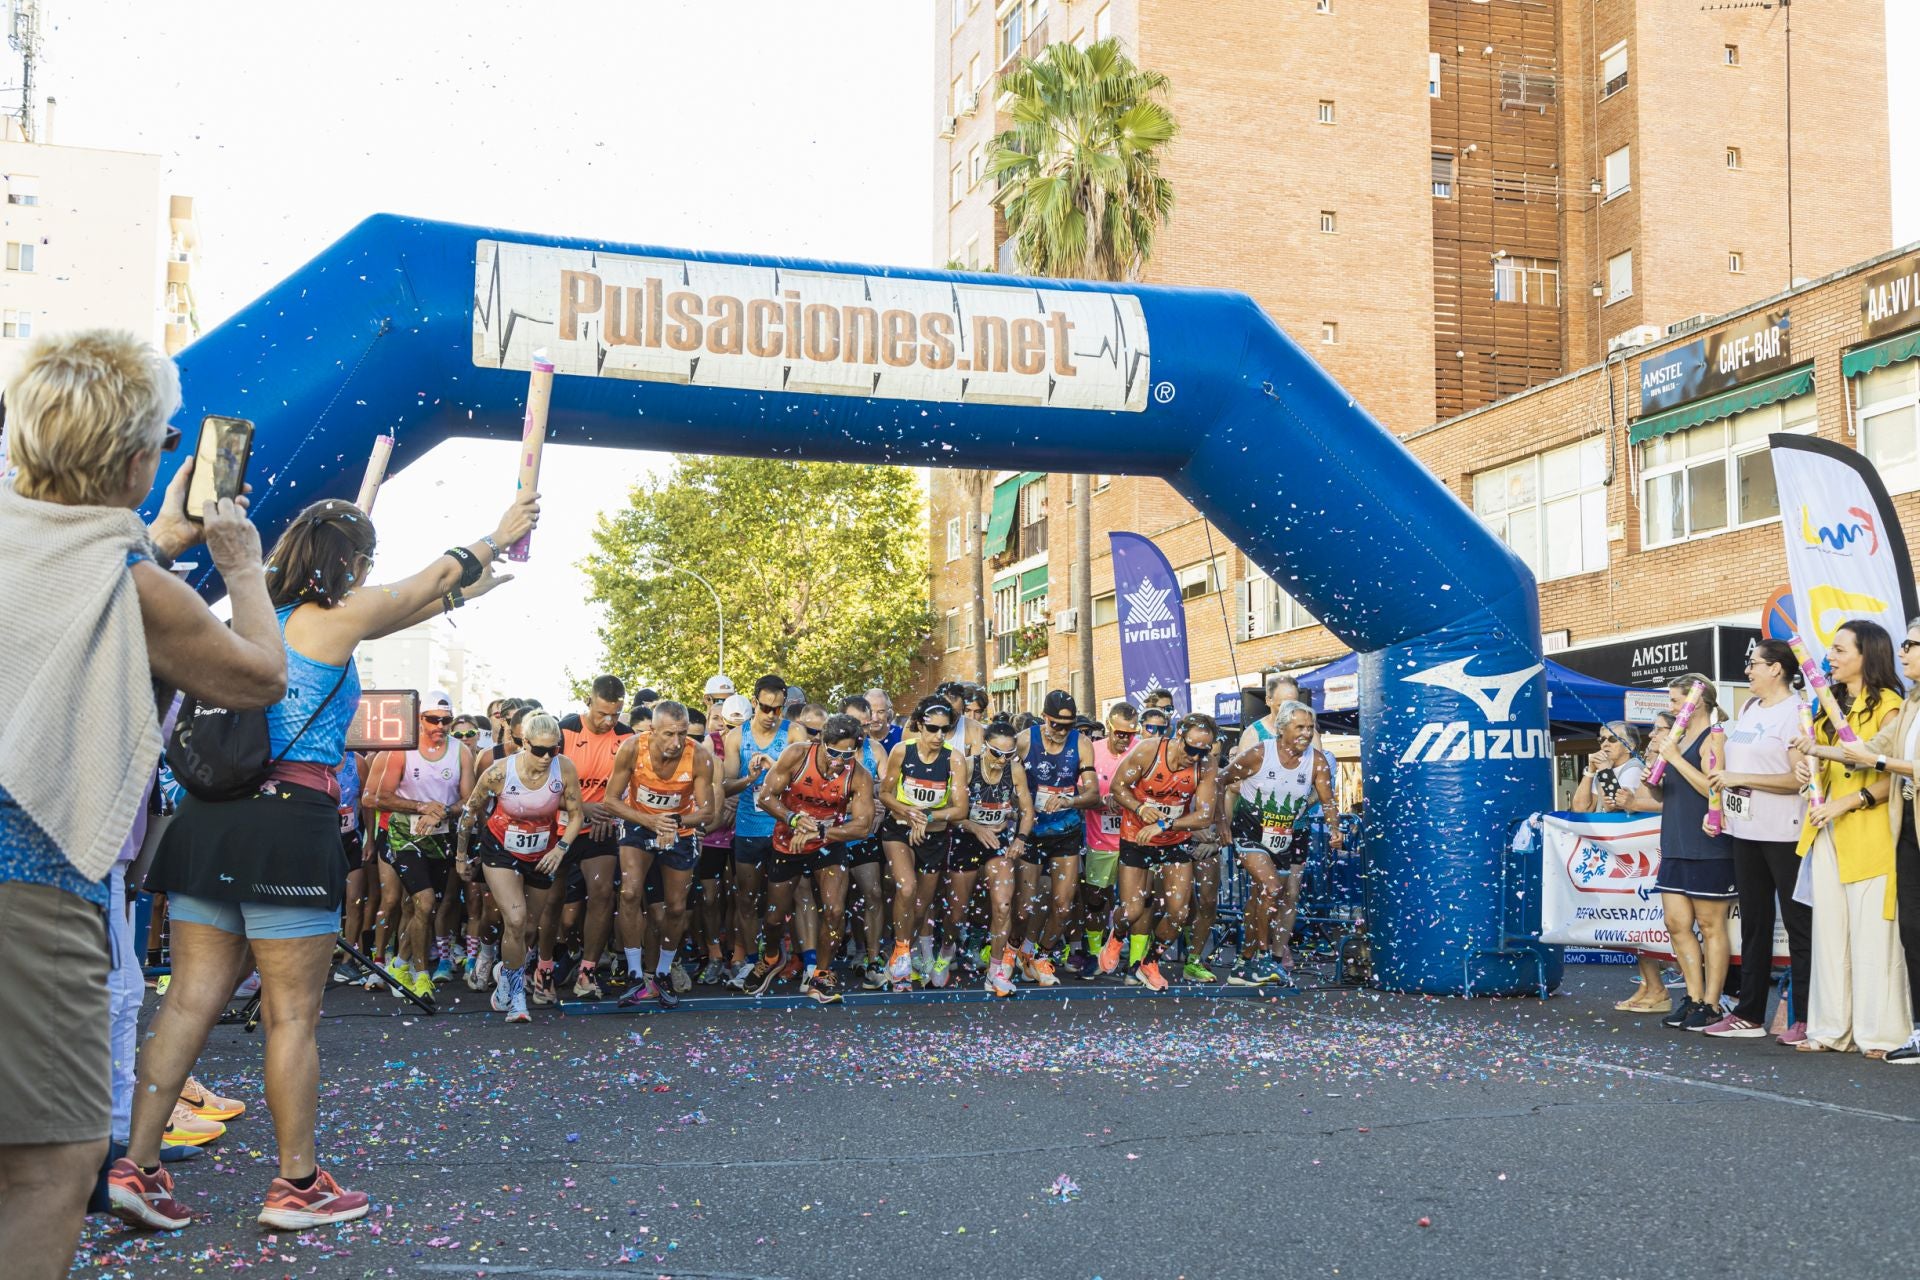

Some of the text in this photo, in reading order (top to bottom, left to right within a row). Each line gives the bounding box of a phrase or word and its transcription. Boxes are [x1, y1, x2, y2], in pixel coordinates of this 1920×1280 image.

[558, 269, 1077, 377] Pulsaciones.net
[1719, 325, 1780, 375] CAFE-BAR
[1642, 362, 1683, 389] AMSTEL
[1631, 641, 1689, 668] AMSTEL
[1643, 668, 1658, 676] MALTA
[1668, 664, 1689, 672] CEBADA
[646, 793, 670, 805] 277
[913, 788, 936, 802] 100
[1726, 794, 1743, 813] 498
[977, 810, 1002, 821] 258
[516, 834, 540, 847] 317
[1270, 835, 1287, 848] 198
